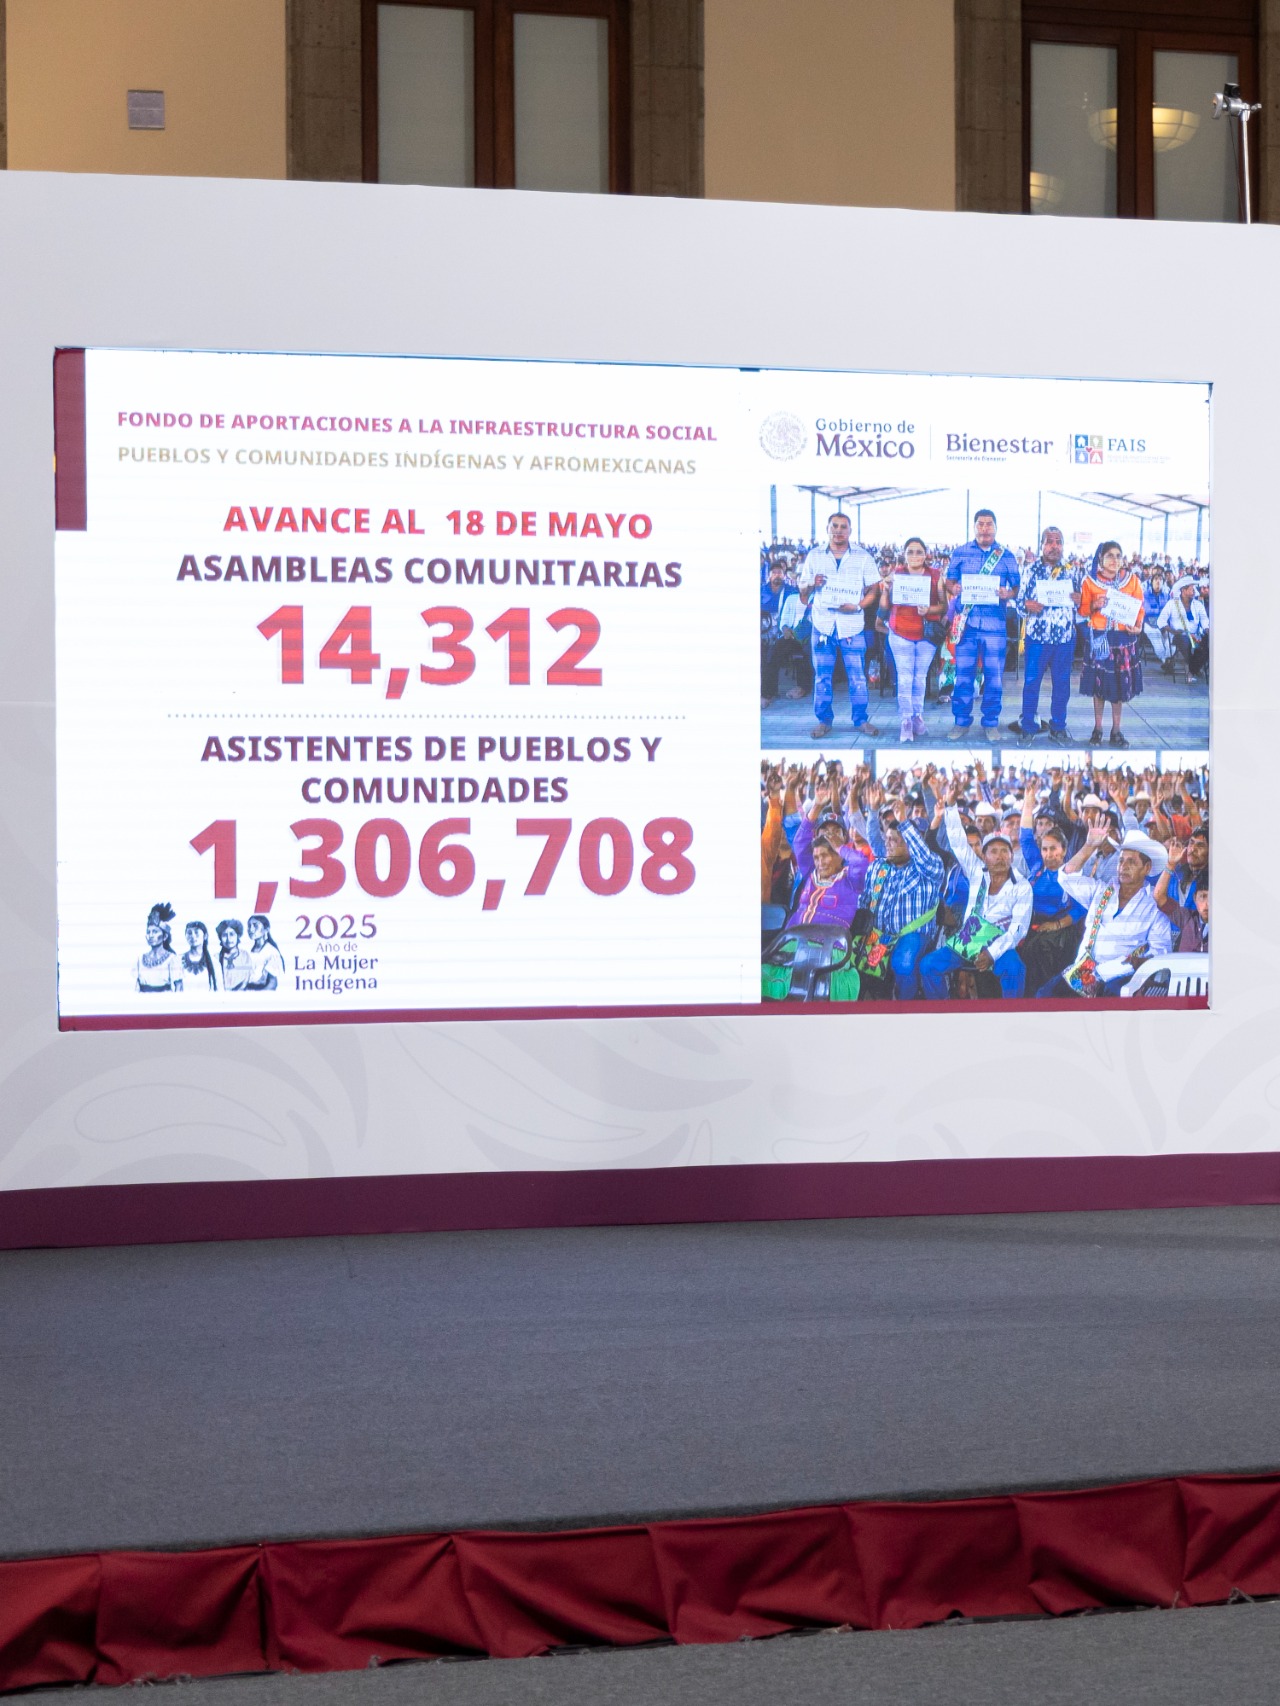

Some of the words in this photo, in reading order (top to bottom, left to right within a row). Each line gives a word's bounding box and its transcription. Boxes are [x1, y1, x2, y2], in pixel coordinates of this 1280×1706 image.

[118, 412, 192, 428] FONDO
[200, 414, 224, 428] DE
[231, 415, 392, 432] APORTACIONES
[399, 419, 412, 432] A
[419, 419, 443, 433] LA
[450, 420, 640, 439] INFRAESTRUCTURA
[646, 425, 717, 440] SOCIAL
[815, 418, 892, 433] Gobierno
[898, 421, 914, 433] de
[816, 433, 915, 459] México
[947, 433, 1053, 454] Bienestar
[1108, 439, 1145, 451] FAIS
[119, 447, 210, 463] PUEBLOS
[217, 449, 228, 463] Y
[236, 449, 388, 467] COMUNIDADES
[396, 450, 506, 469] INDÍGENAS
[513, 456, 524, 469] Y
[530, 456, 695, 474] AFROMEXICANAS
[223, 506, 369, 534] AVANCE
[381, 509, 425, 534] AL
[446, 510, 484, 536] 18
[496, 511, 536, 536] DE
[549, 512, 652, 539] MAYO
[177, 555, 392, 583] ASAMBLEAS
[405, 558, 682, 587] COMUNITARIAS
[257, 605, 602, 699] 14,312
[201, 736, 412, 762] ASISTENTES
[425, 736, 465, 761] DE
[479, 736, 631, 762] PUEBLOS
[641, 737, 662, 761] Y
[302, 777, 568, 803] COMUNIDADES
[189, 817, 696, 914] 1,306,708
[296, 914, 377, 939] 2025
[343, 941, 358, 952] de
[294, 955, 316, 971] La
[324, 955, 378, 974] Mujer
[295, 974, 377, 995] Indígena
